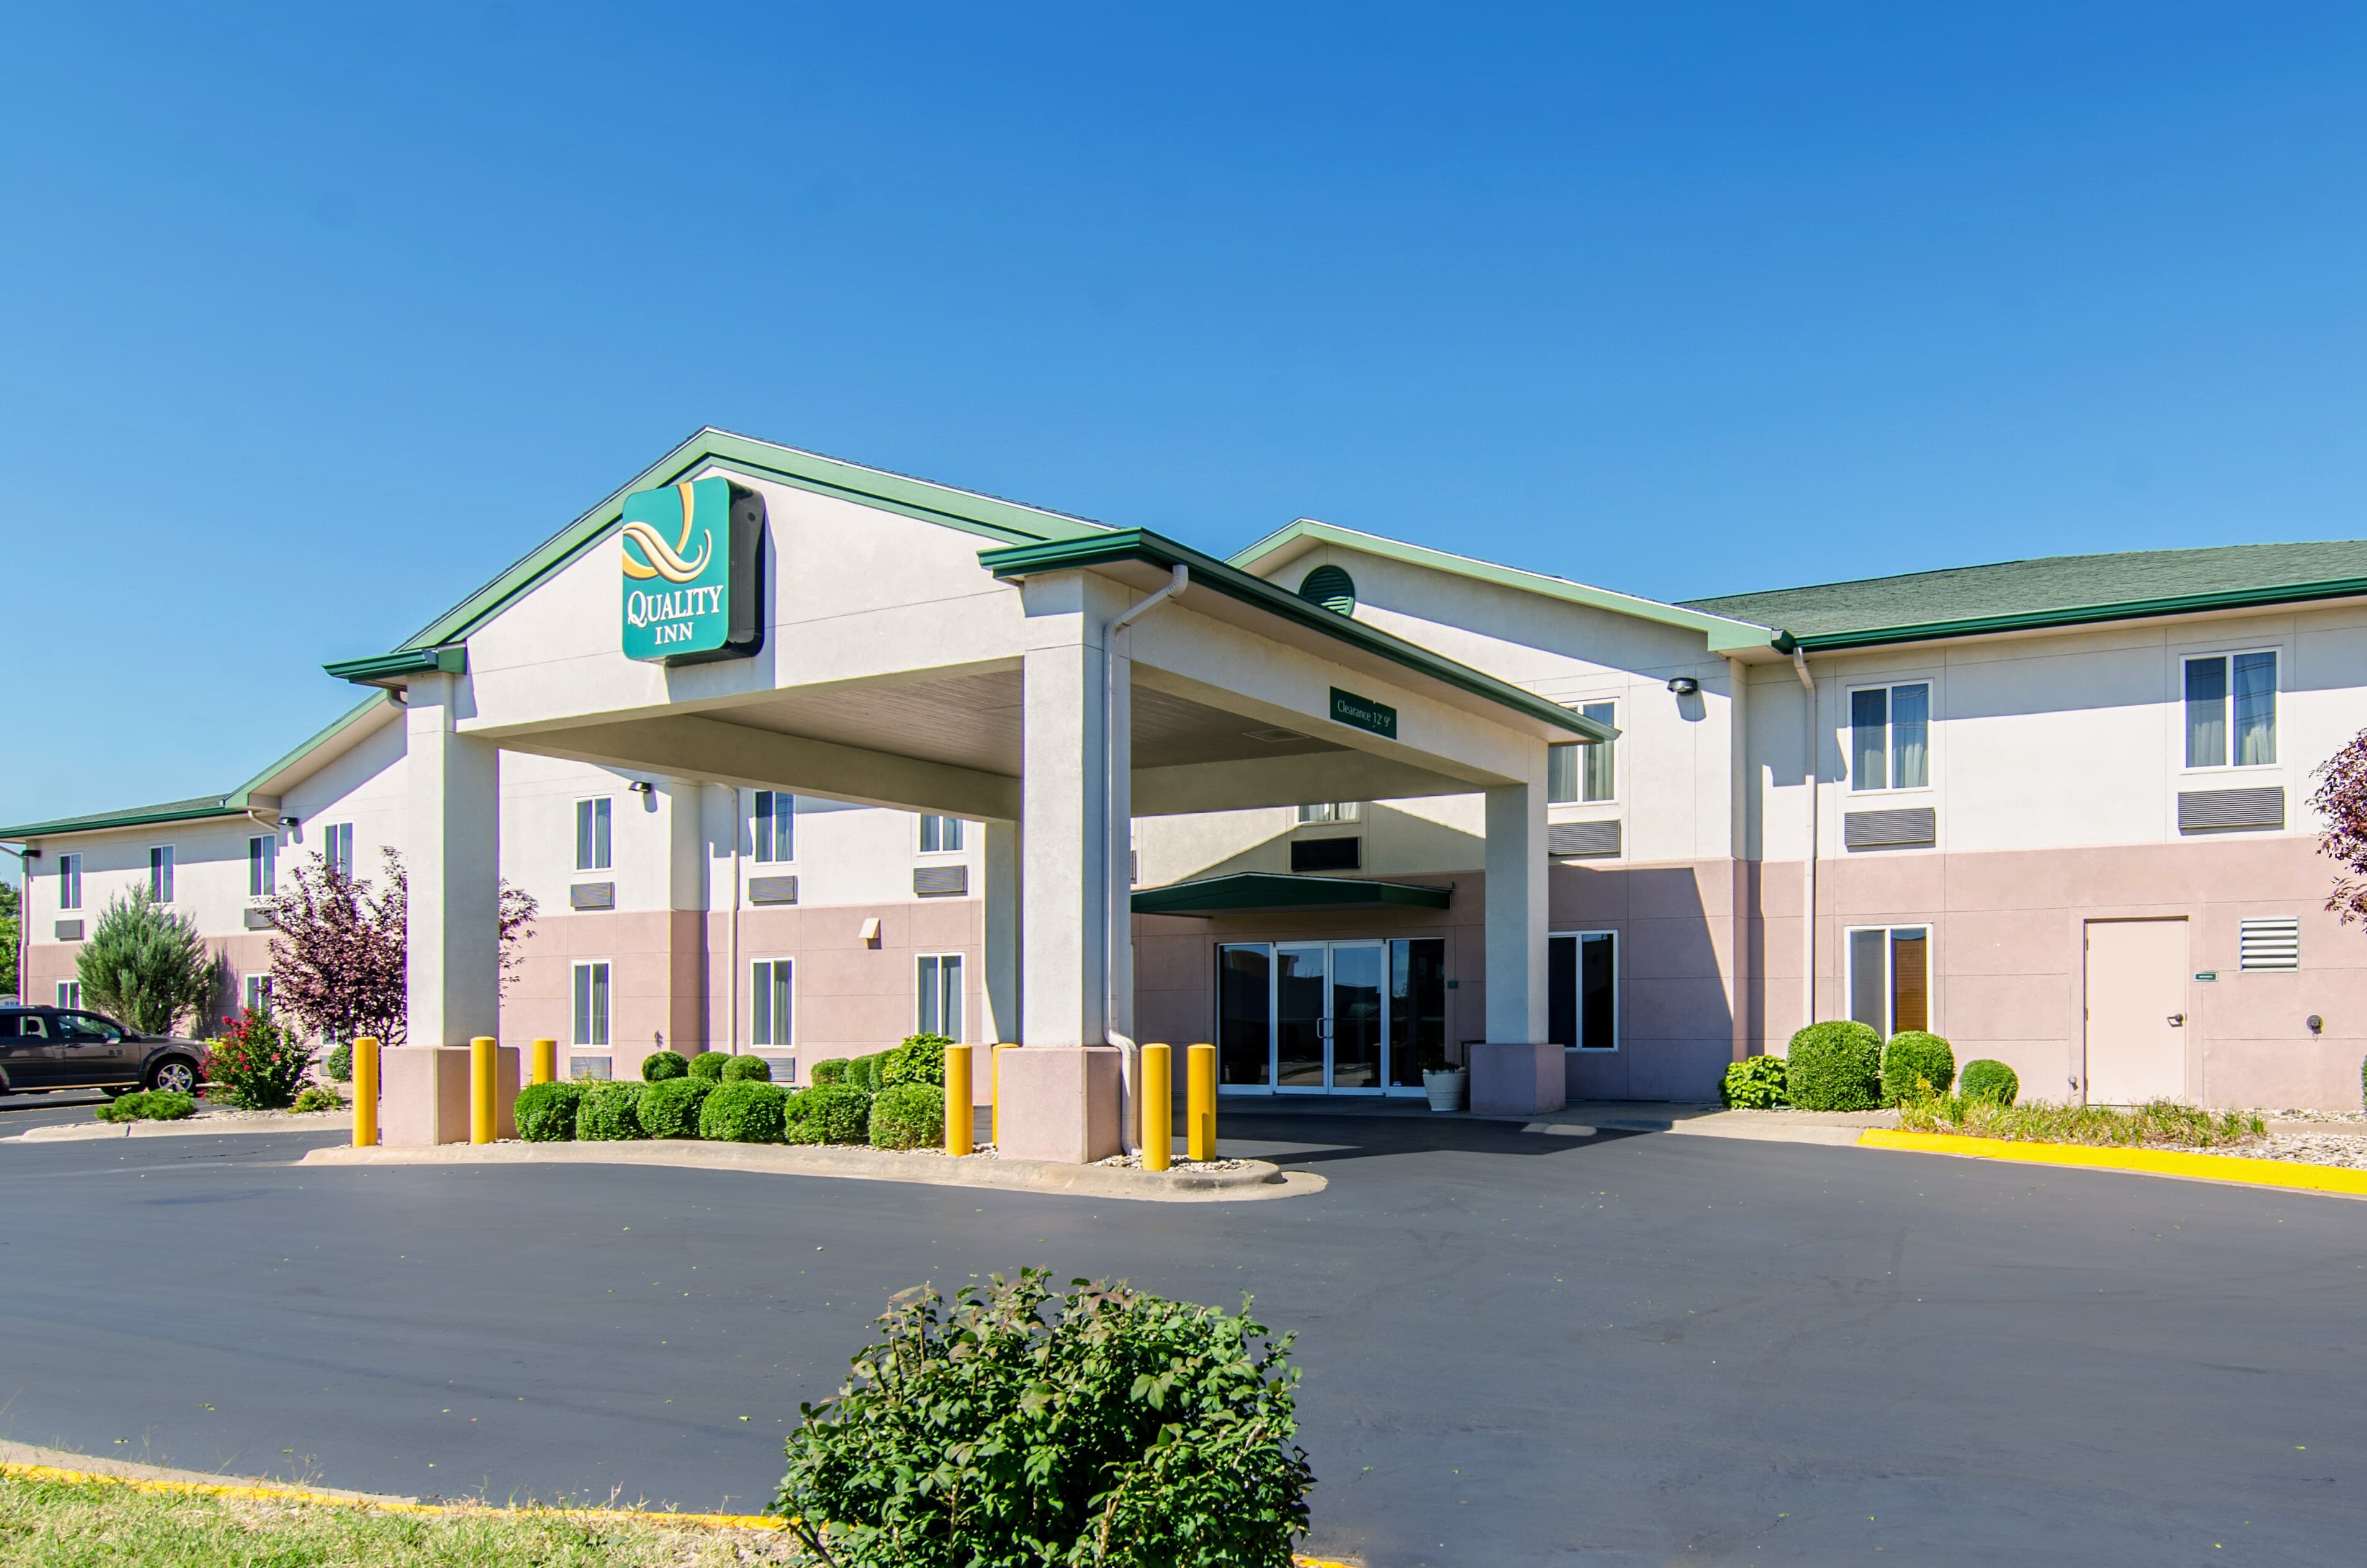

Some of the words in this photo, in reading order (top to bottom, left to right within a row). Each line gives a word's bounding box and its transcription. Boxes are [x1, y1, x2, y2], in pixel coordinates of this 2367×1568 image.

[628, 585, 723, 628] QUALITY
[654, 621, 693, 645] INN
[1337, 700, 1371, 721] Clearance
